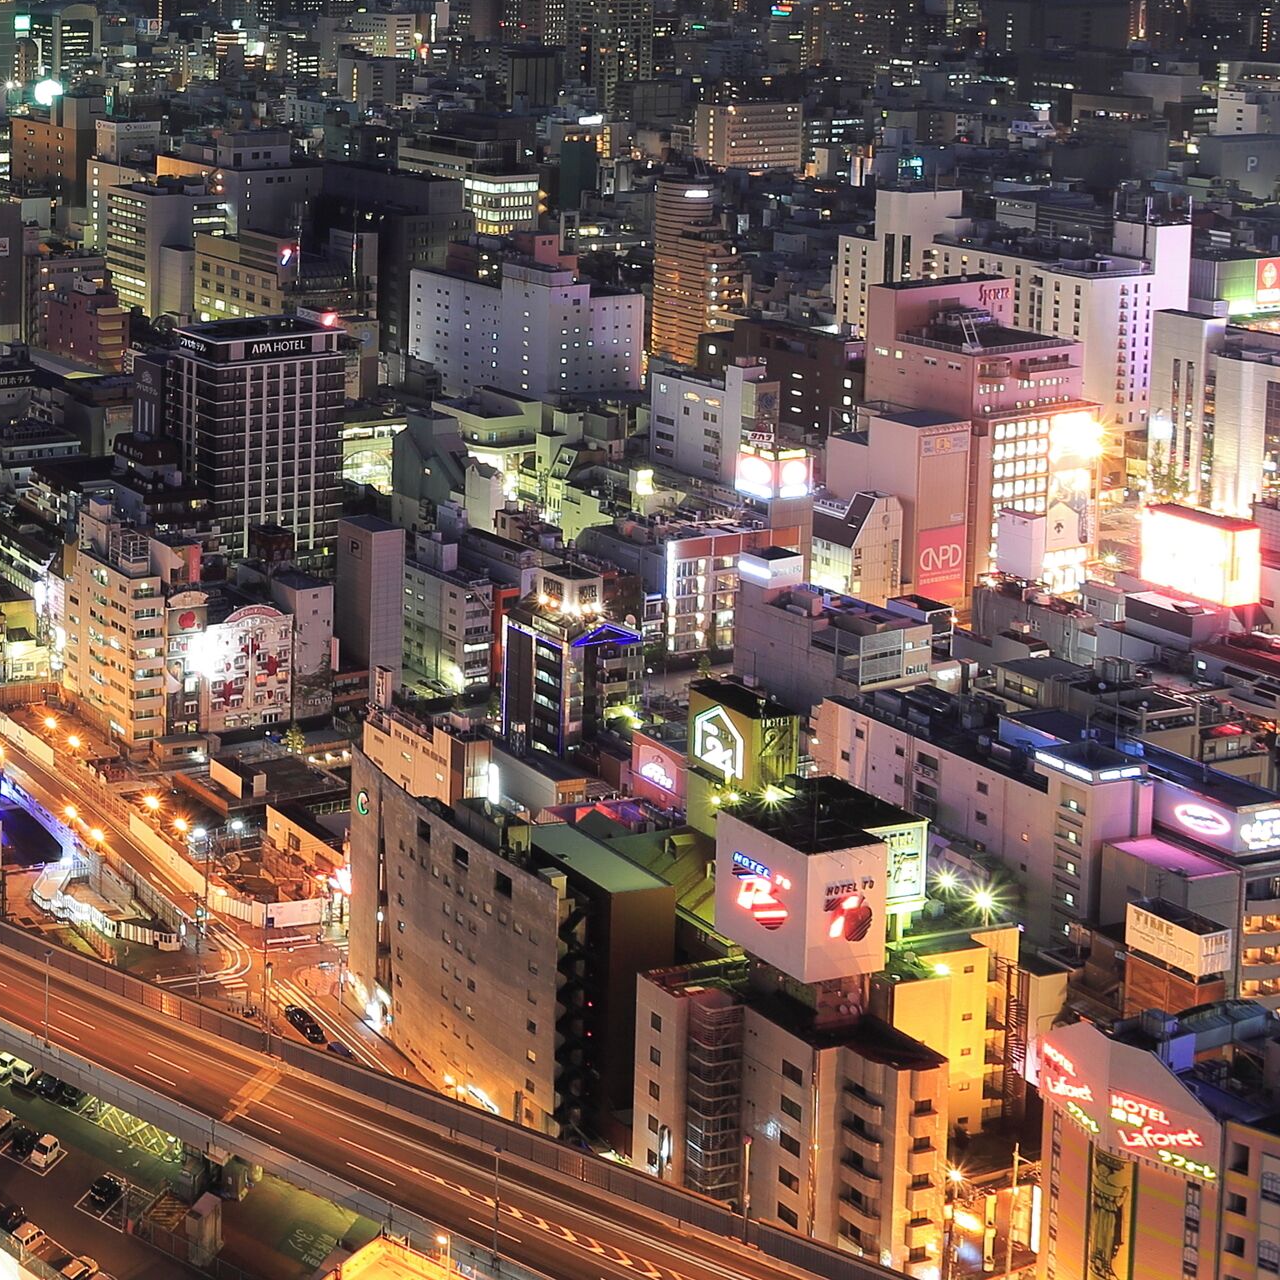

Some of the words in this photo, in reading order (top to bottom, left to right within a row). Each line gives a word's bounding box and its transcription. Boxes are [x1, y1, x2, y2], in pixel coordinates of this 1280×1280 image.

[1246, 156, 1258, 171] P
[251, 343, 272, 354] APA
[273, 339, 306, 352] HOTEL
[350, 539, 360, 554] P
[733, 851, 772, 878] HOTEL
[826, 882, 858, 897] HOTEL
[1134, 909, 1175, 937] TIME
[1043, 1043, 1077, 1077] HOTEL
[1111, 1094, 1170, 1125] HOTEL
[1117, 1125, 1203, 1148] Laforet
